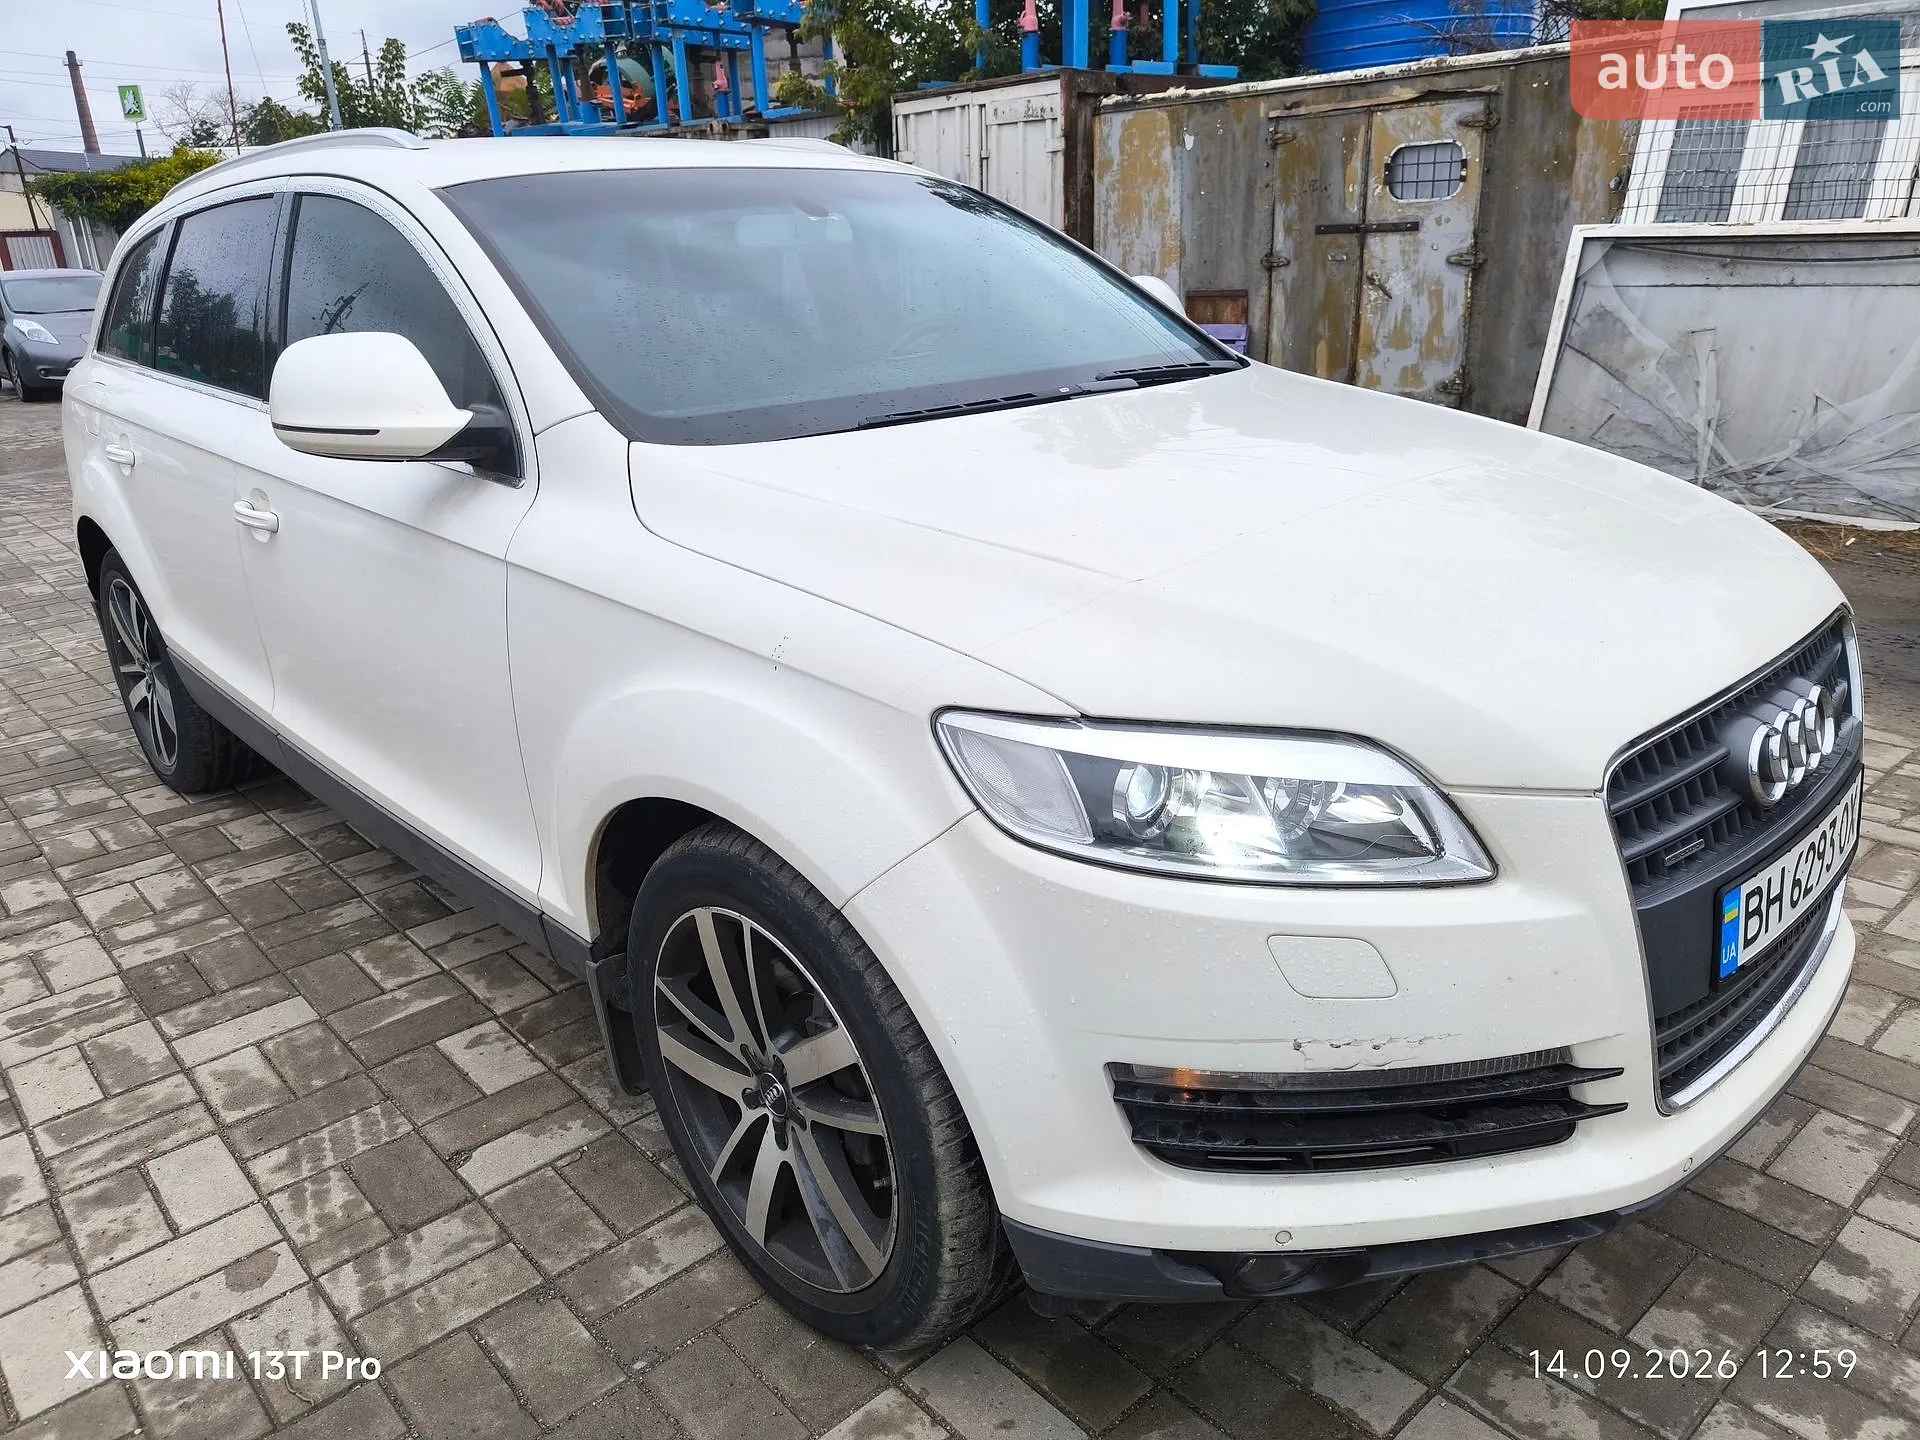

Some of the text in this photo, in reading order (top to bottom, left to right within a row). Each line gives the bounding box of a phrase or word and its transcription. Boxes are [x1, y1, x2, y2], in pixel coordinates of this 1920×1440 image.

[1742, 784, 1859, 951] BH 6293 OX
[1722, 943, 1737, 965] UA
